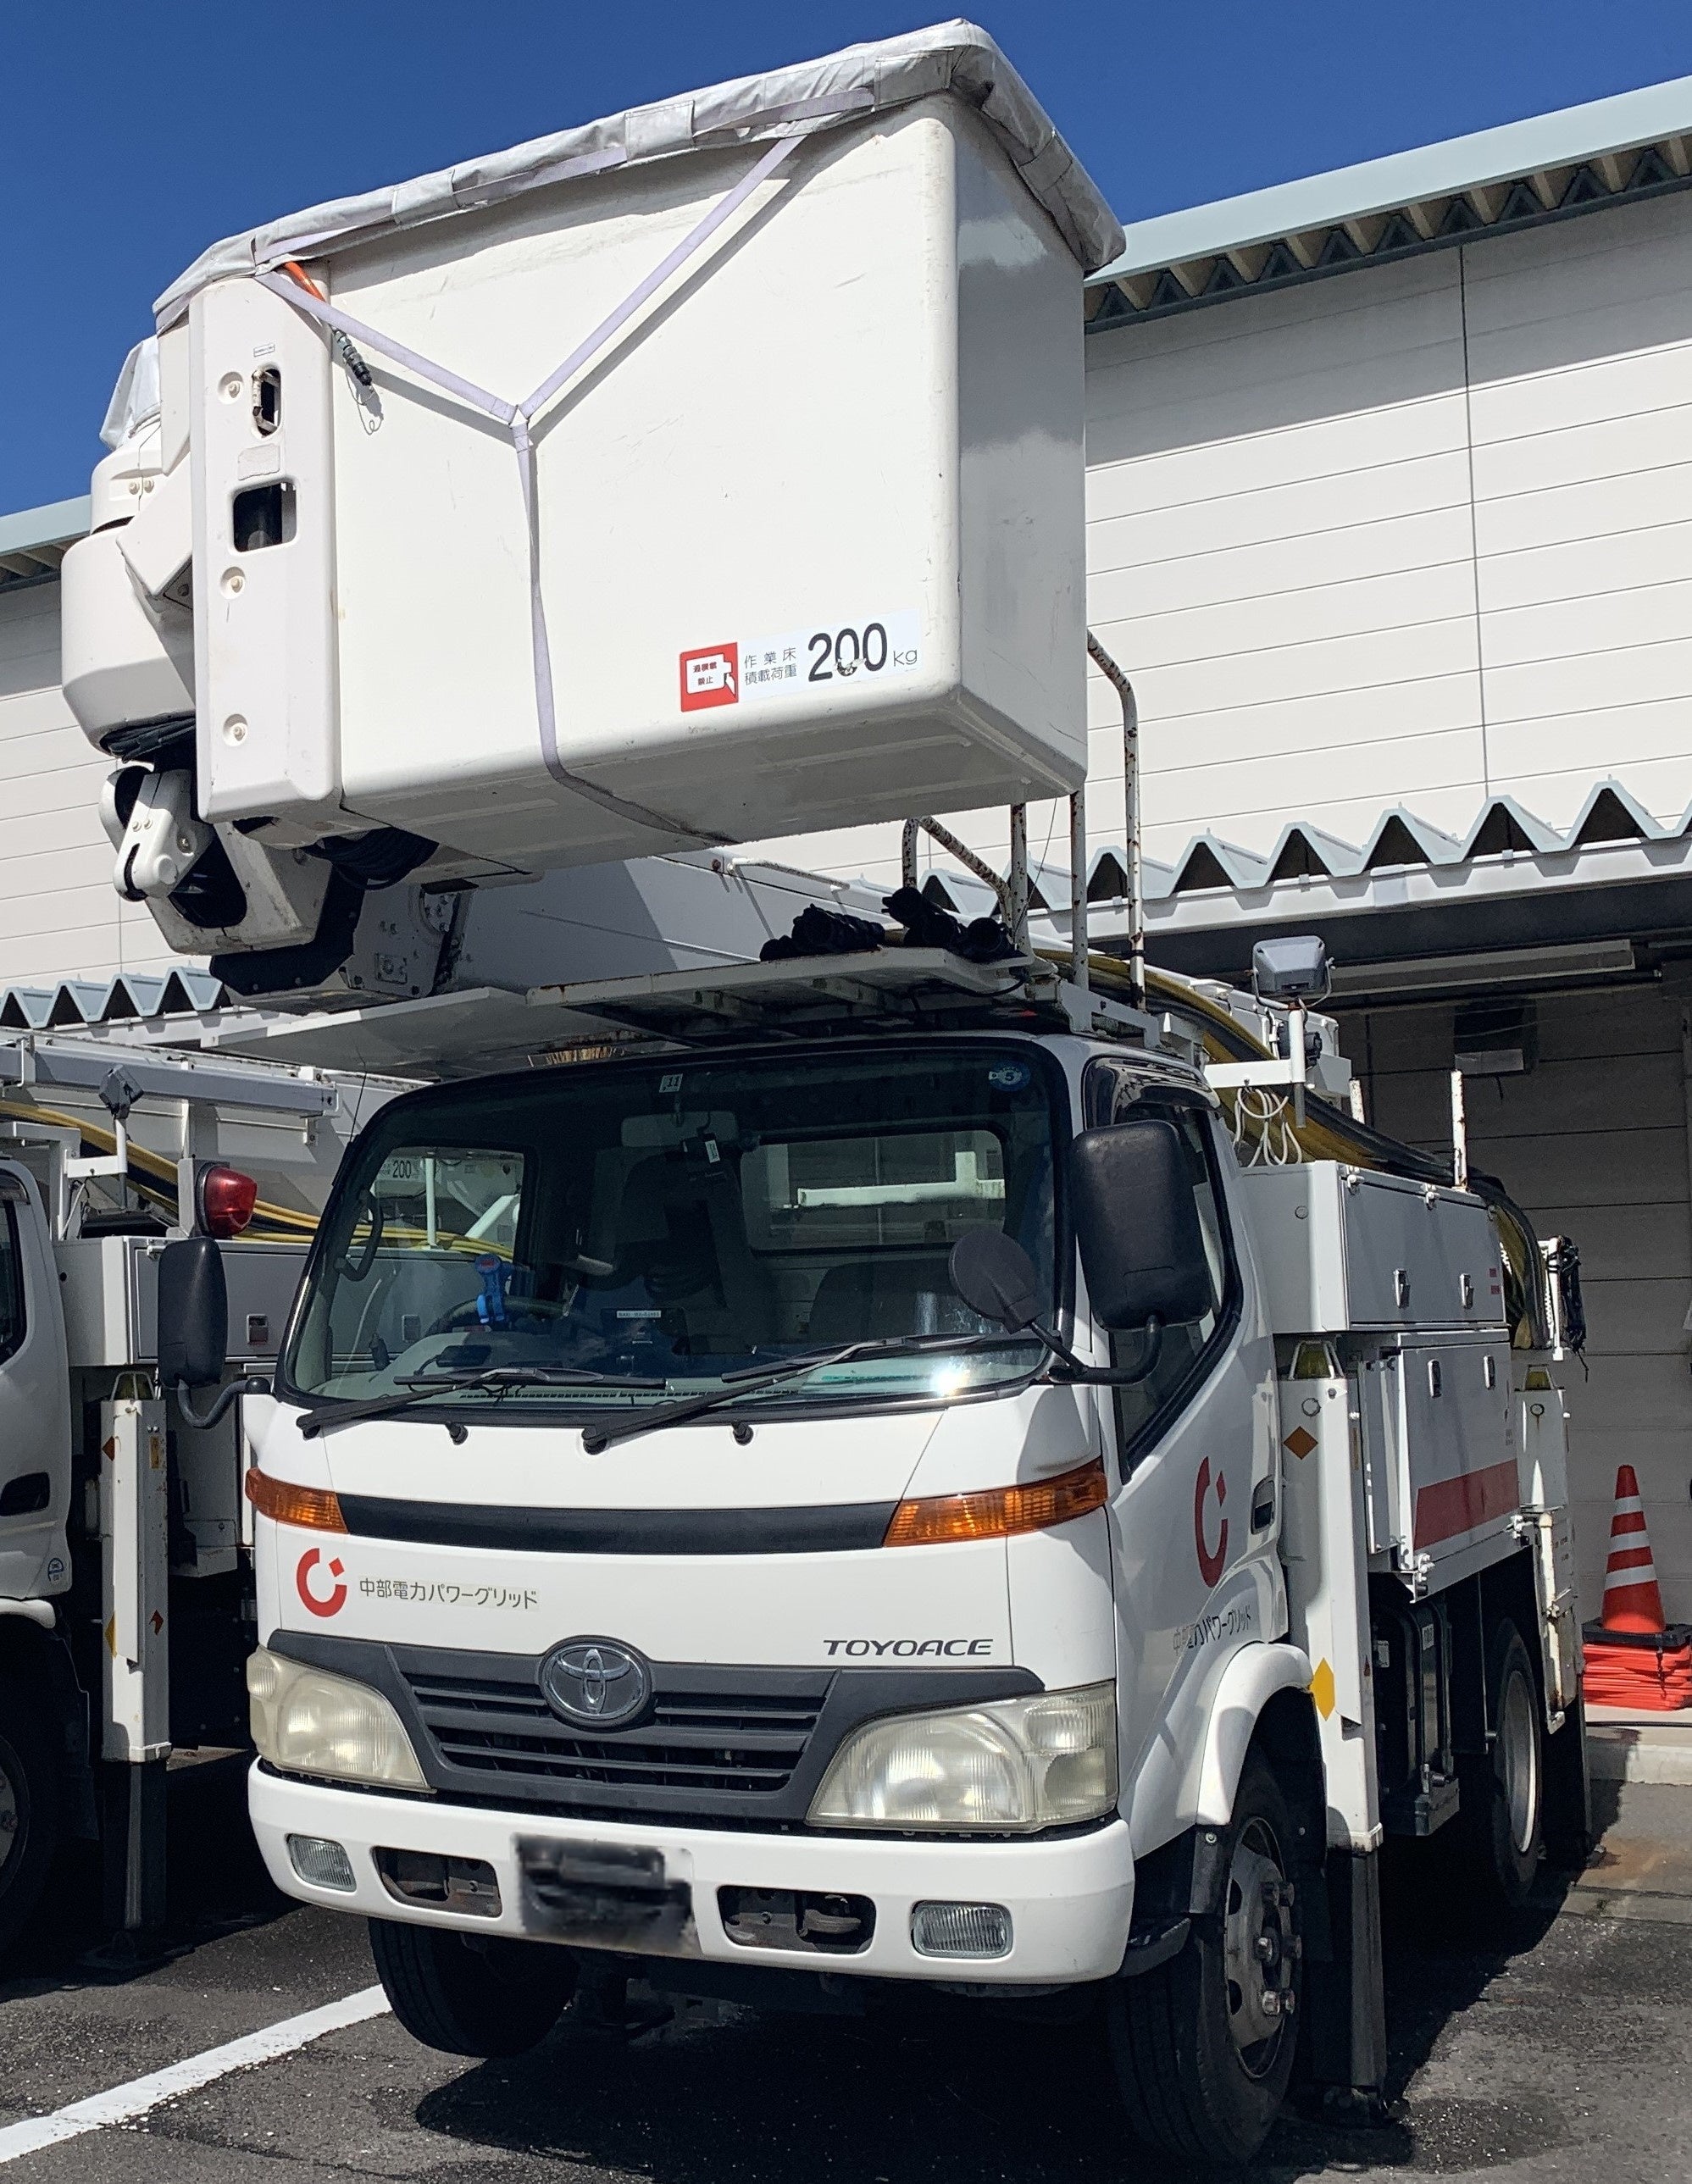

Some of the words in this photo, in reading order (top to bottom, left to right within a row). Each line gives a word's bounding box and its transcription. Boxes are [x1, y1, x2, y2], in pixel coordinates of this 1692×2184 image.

[745, 647, 796, 669] 作業床
[807, 623, 888, 682] 200
[893, 650, 918, 667] kg
[745, 663, 797, 685] 積載荷重
[392, 1160, 412, 1178] 200
[359, 1577, 537, 1610] 中部電力パワーグリッド
[823, 1638, 994, 1656] TOYOACE
